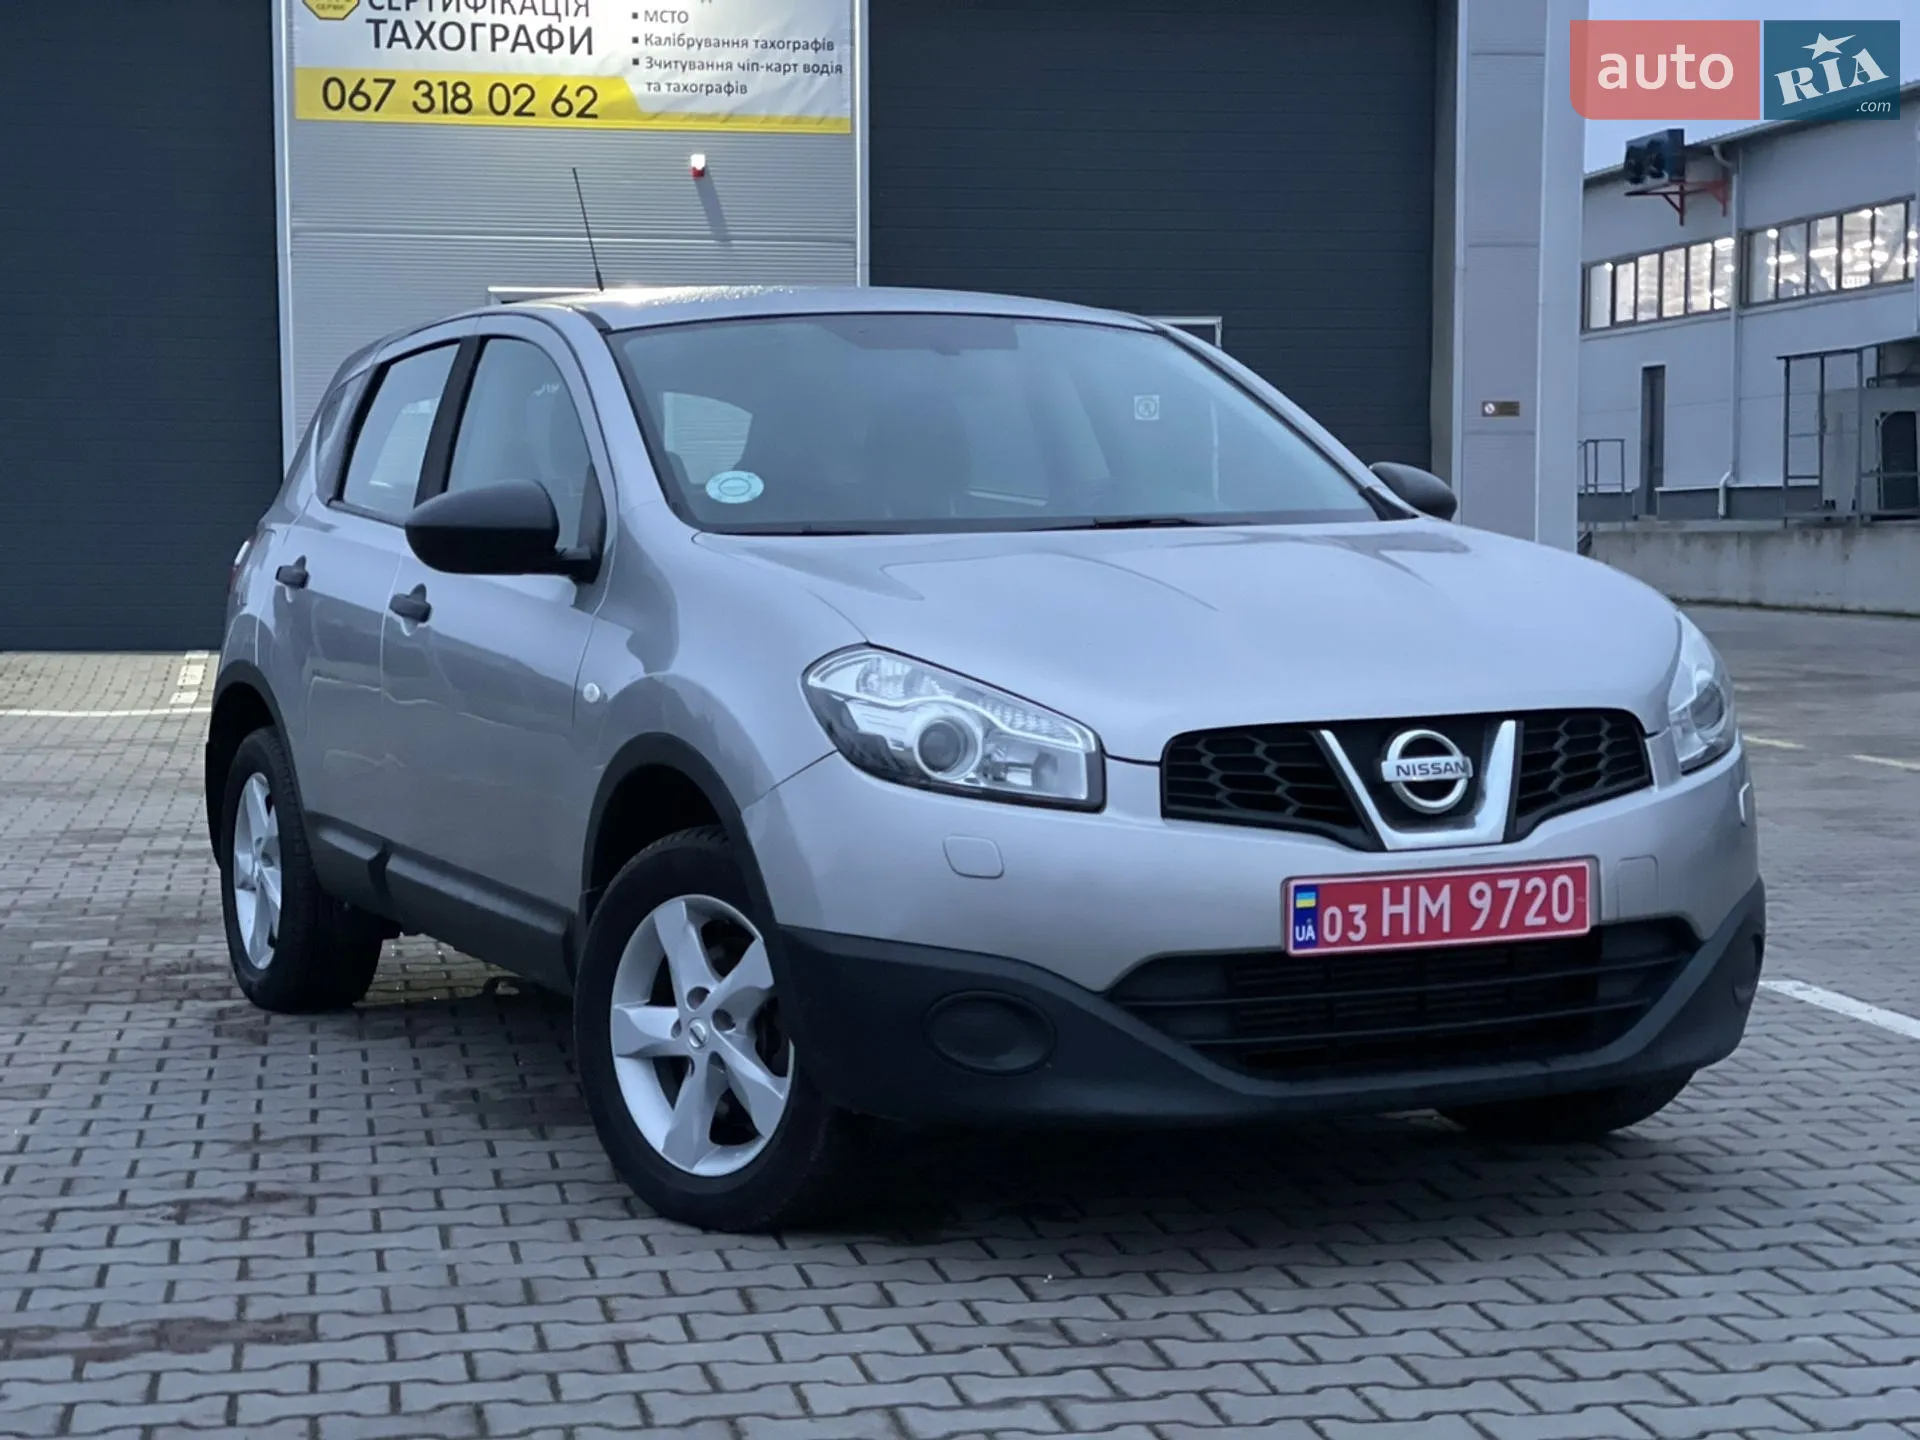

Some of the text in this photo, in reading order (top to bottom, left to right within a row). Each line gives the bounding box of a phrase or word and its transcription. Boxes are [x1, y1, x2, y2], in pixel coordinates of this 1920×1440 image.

[644, 10, 689, 24] МСТО
[365, 18, 593, 55] ТАХОГРАФИ
[644, 32, 835, 53] Калібрування тахографів
[645, 56, 843, 76] Зчитування чіп-карт водія
[322, 76, 598, 119] 067 318 02 62
[646, 80, 748, 97] та тахографів
[1396, 762, 1466, 777] NISSAN
[1322, 874, 1575, 943] 03 HM 9720
[1295, 924, 1316, 943] UA
